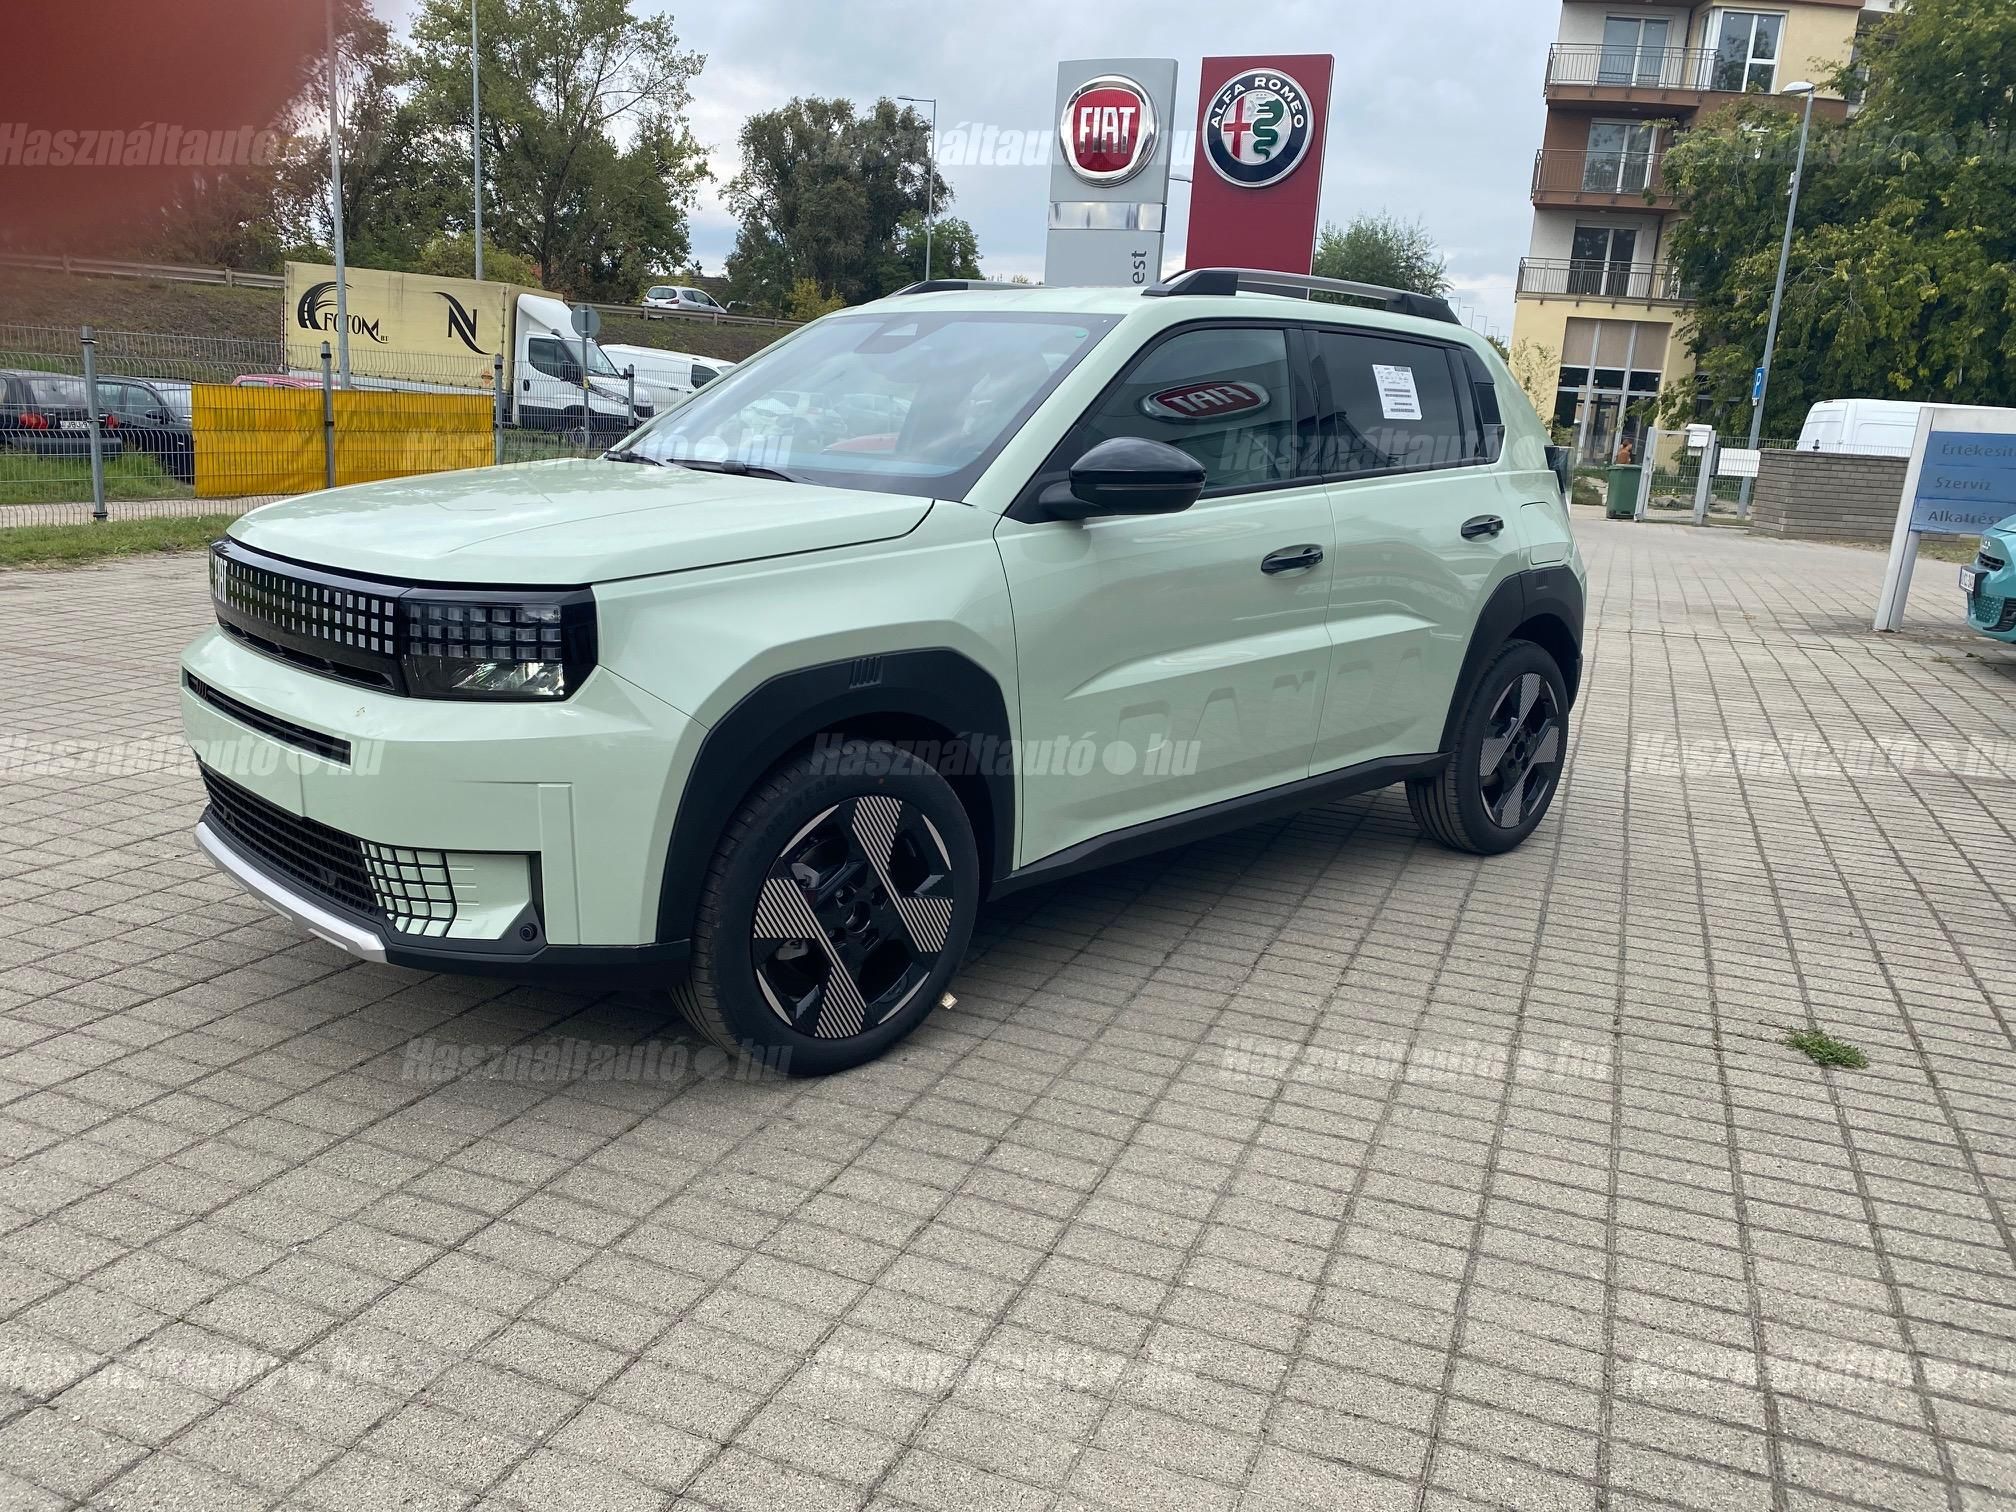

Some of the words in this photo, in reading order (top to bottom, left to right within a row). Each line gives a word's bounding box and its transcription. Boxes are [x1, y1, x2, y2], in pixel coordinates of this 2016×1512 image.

[1210, 83, 1246, 129] ALFA
[1254, 77, 1305, 128] ROMEO
[1079, 106, 1137, 154] FIAT
[1942, 441, 2016, 457] Értékesít
[1935, 477, 1992, 491] Szerviz
